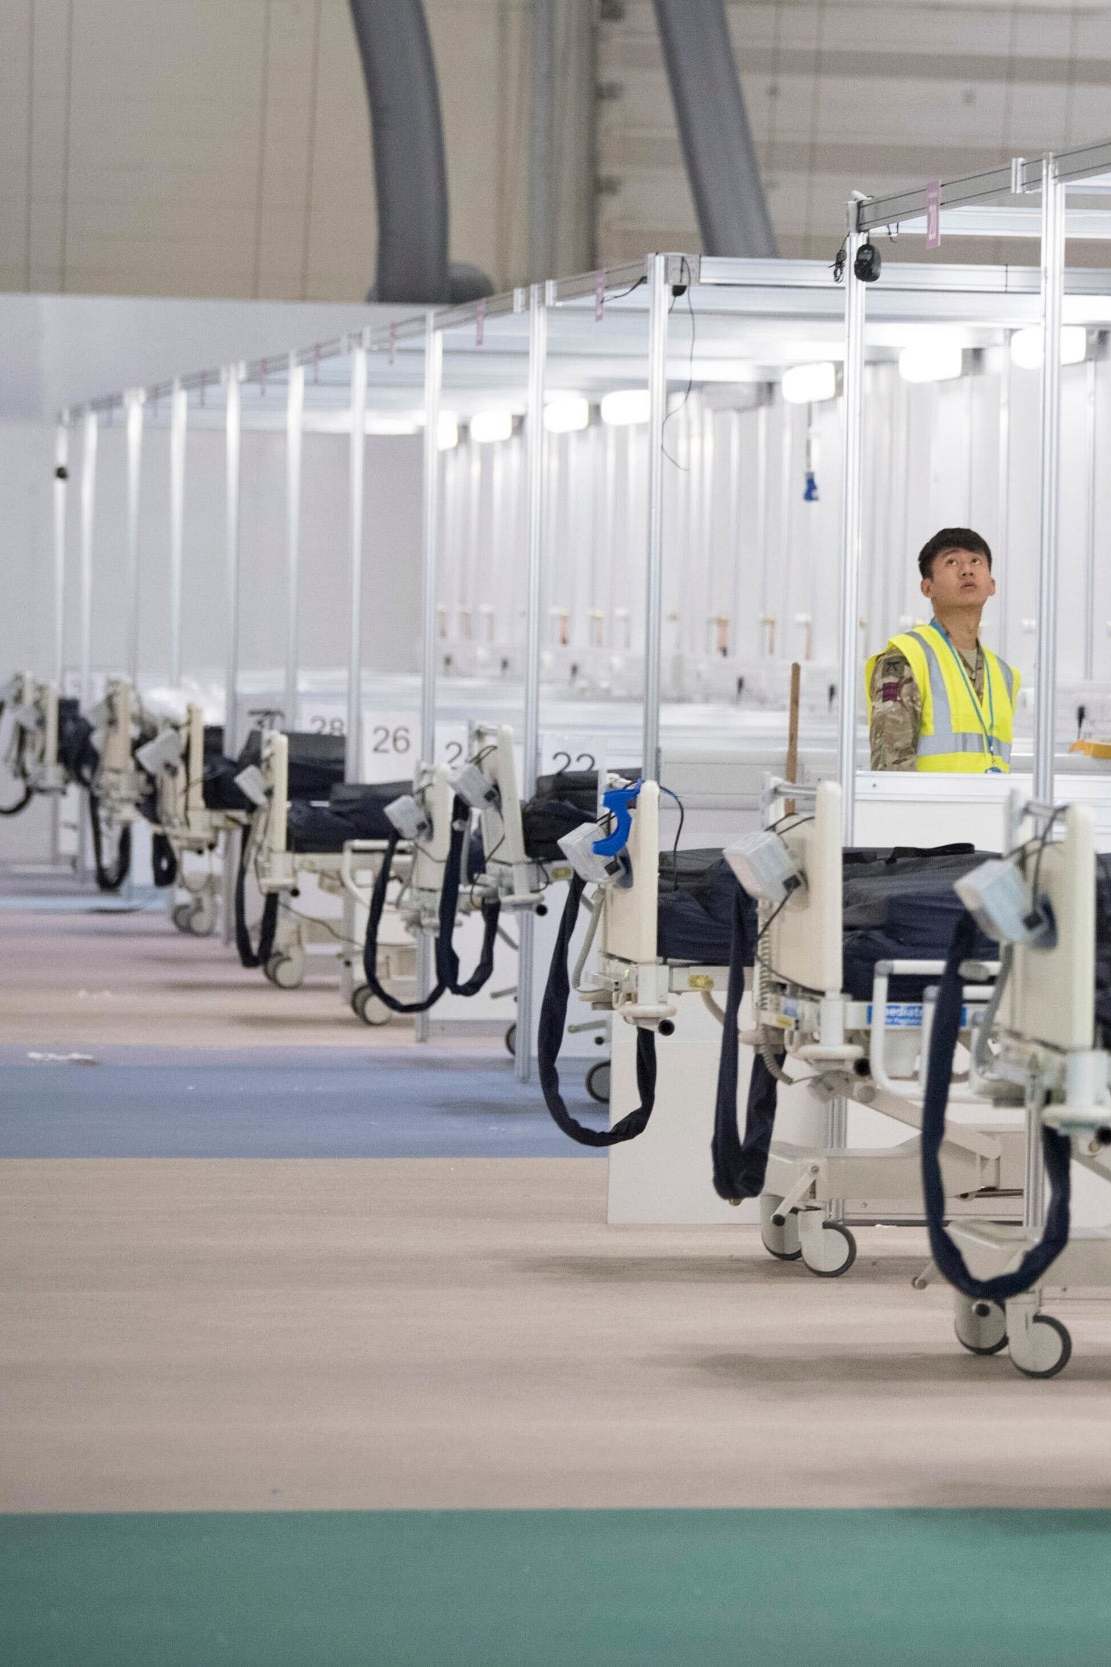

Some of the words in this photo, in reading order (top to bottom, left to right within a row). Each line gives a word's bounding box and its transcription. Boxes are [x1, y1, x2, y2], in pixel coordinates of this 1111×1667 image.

[311, 714, 344, 736] 28
[373, 726, 411, 754] 26
[552, 752, 595, 774] 22
